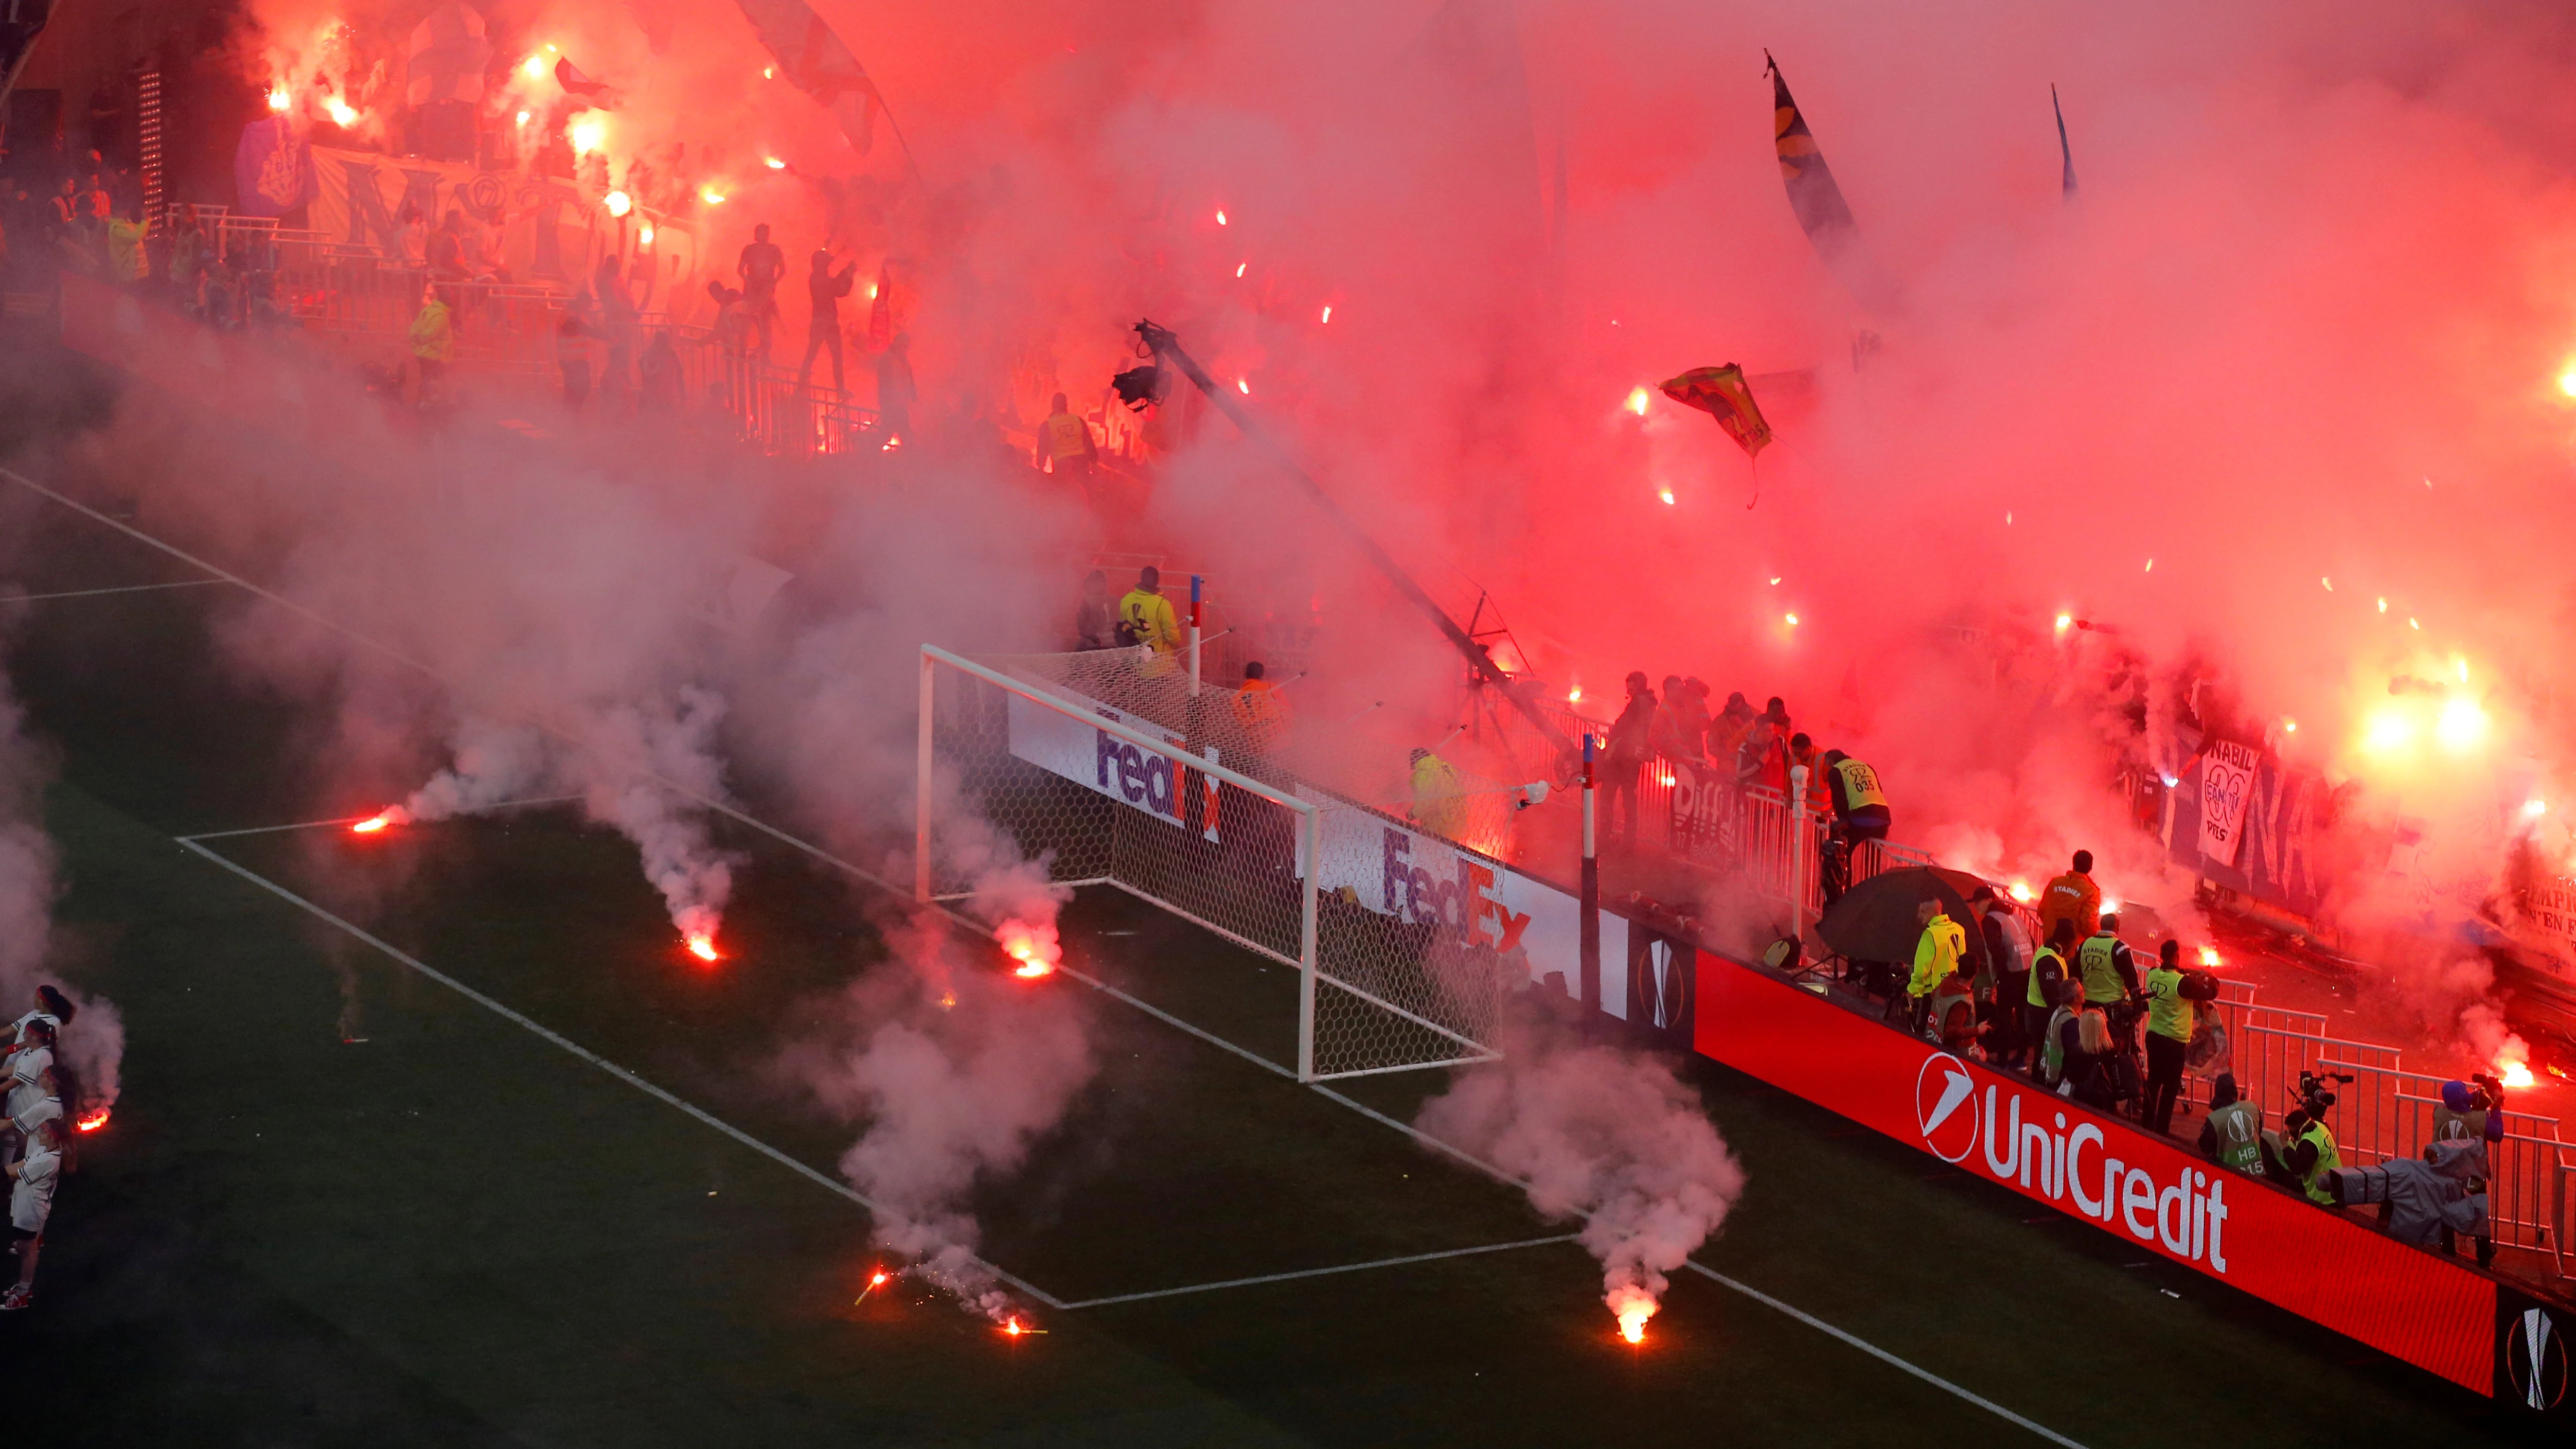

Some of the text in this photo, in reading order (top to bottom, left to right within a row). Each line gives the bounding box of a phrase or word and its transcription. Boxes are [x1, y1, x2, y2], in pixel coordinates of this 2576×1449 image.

[2210, 740, 2252, 772] NABIL
[1855, 780, 1874, 792] 035
[1384, 827, 1532, 954] FedEx
[2054, 886, 2081, 898] STADIER
[2084, 947, 2108, 957] STADIER
[2237, 1146, 2256, 1161] HB
[1984, 1084, 2228, 1274] UniCredit
